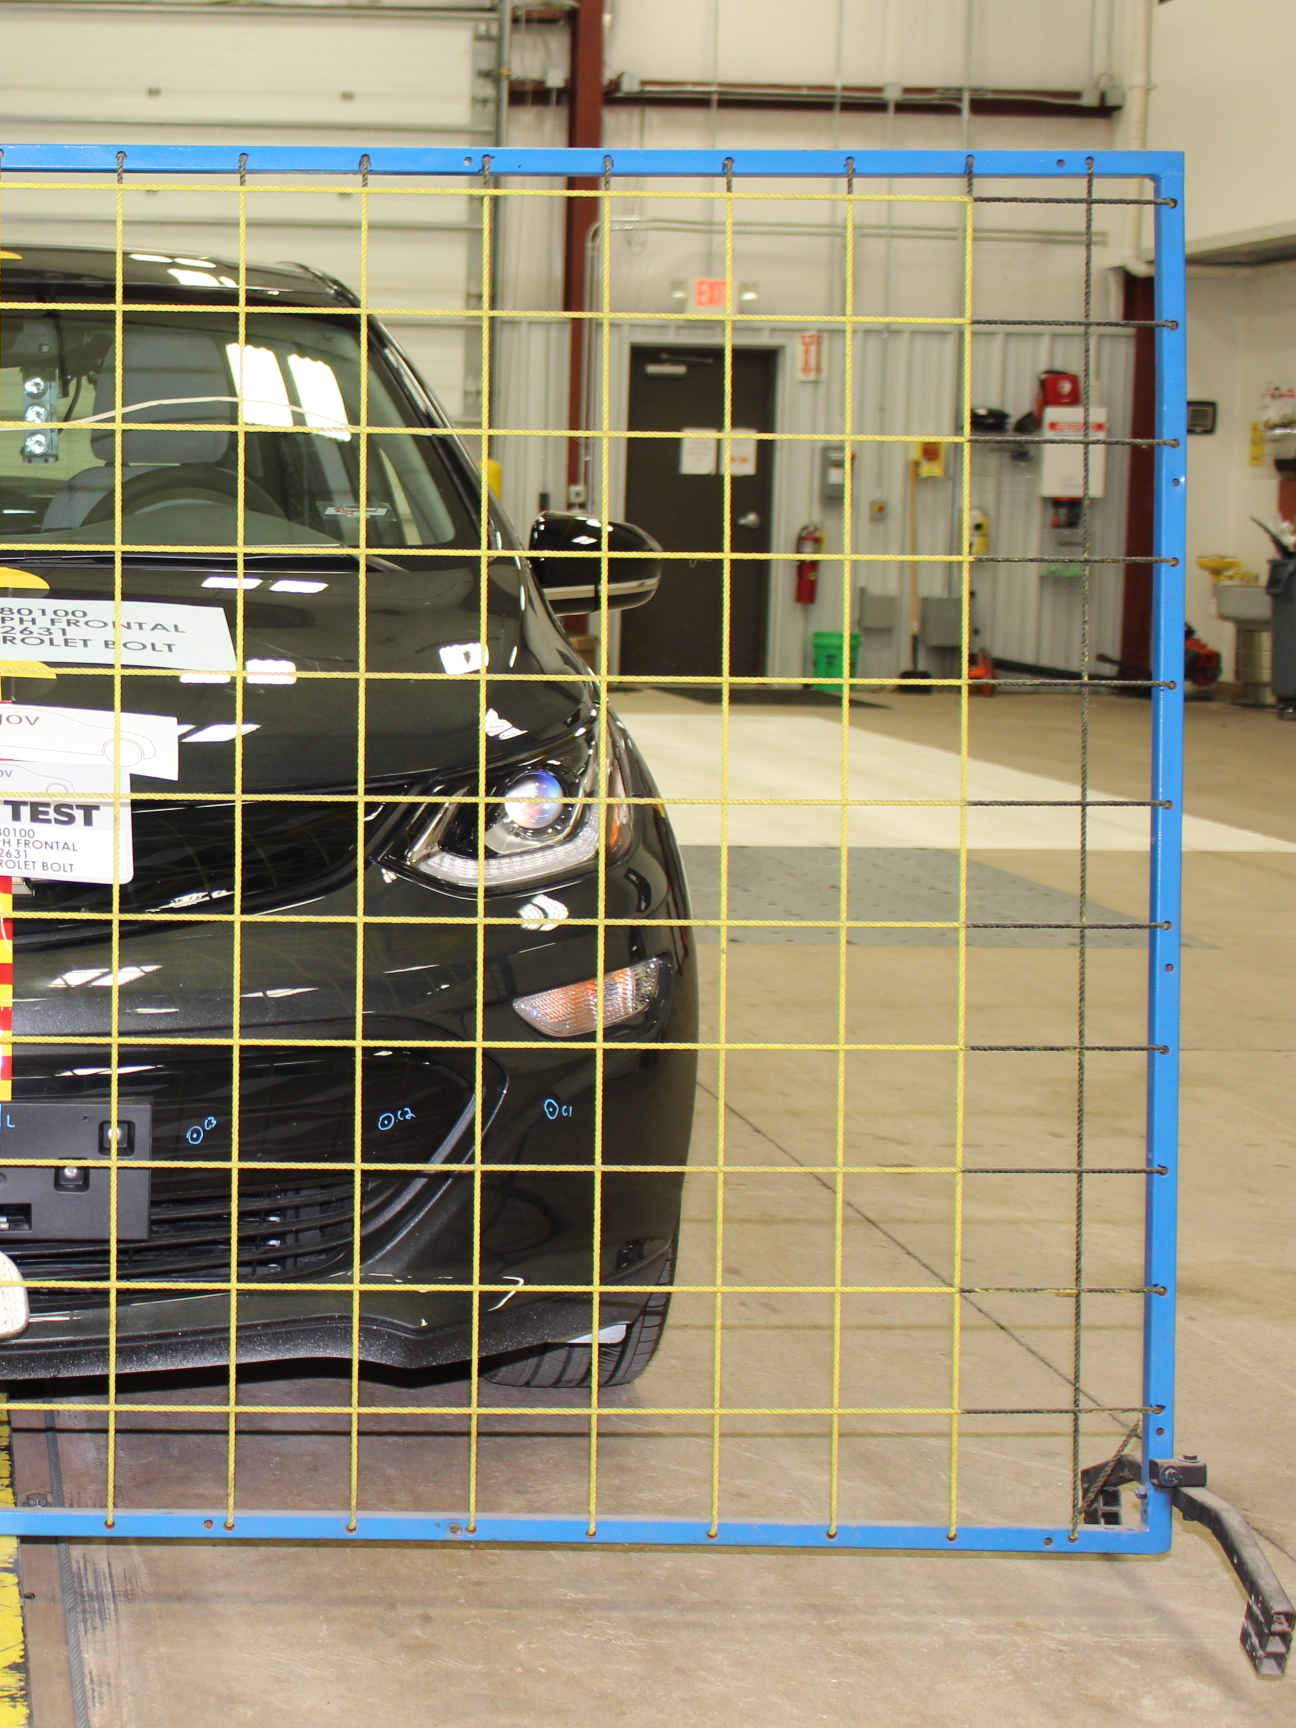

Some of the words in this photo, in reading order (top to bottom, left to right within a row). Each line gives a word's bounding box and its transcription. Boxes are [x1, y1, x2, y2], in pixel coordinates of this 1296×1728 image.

[50, 617, 186, 633] FRONTAL
[103, 640, 177, 653] BOLT
[3, 800, 101, 827] TEST
[16, 838, 78, 852] FRONTAL
[42, 861, 75, 873] BOLT
